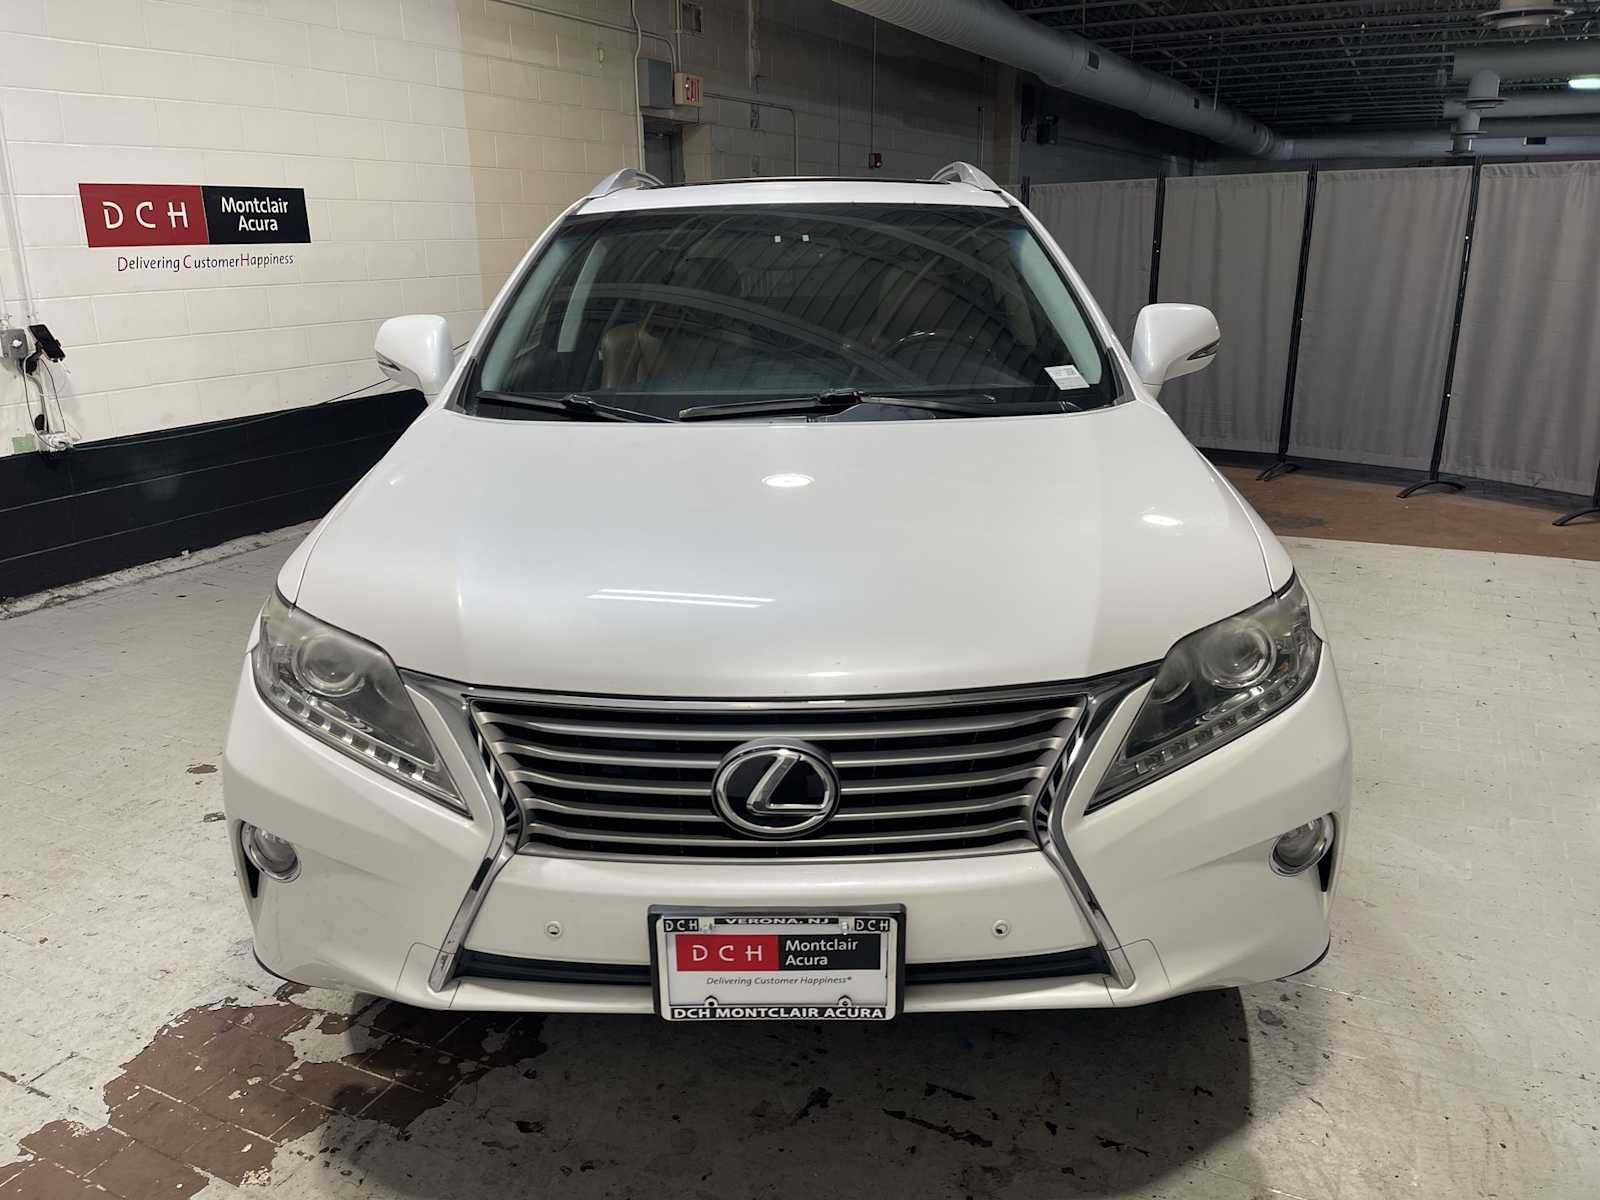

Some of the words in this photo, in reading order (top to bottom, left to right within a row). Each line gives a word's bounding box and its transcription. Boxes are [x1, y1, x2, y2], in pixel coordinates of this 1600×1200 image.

[221, 196, 289, 214] Montclair
[102, 201, 189, 229] DCH
[238, 215, 279, 232] Acura
[117, 256, 180, 272] Delivering
[665, 919, 698, 931] DCH
[856, 919, 889, 931] DCH
[785, 938, 859, 952] Montclair
[691, 944, 763, 962] DCH
[785, 954, 829, 966] Acura
[706, 976, 752, 987] Delivering
[754, 976, 798, 985] Customer
[673, 1008, 710, 1019] DCH
[715, 1008, 819, 1019] MONTCLAIR
[824, 1008, 884, 1019] ACURA
